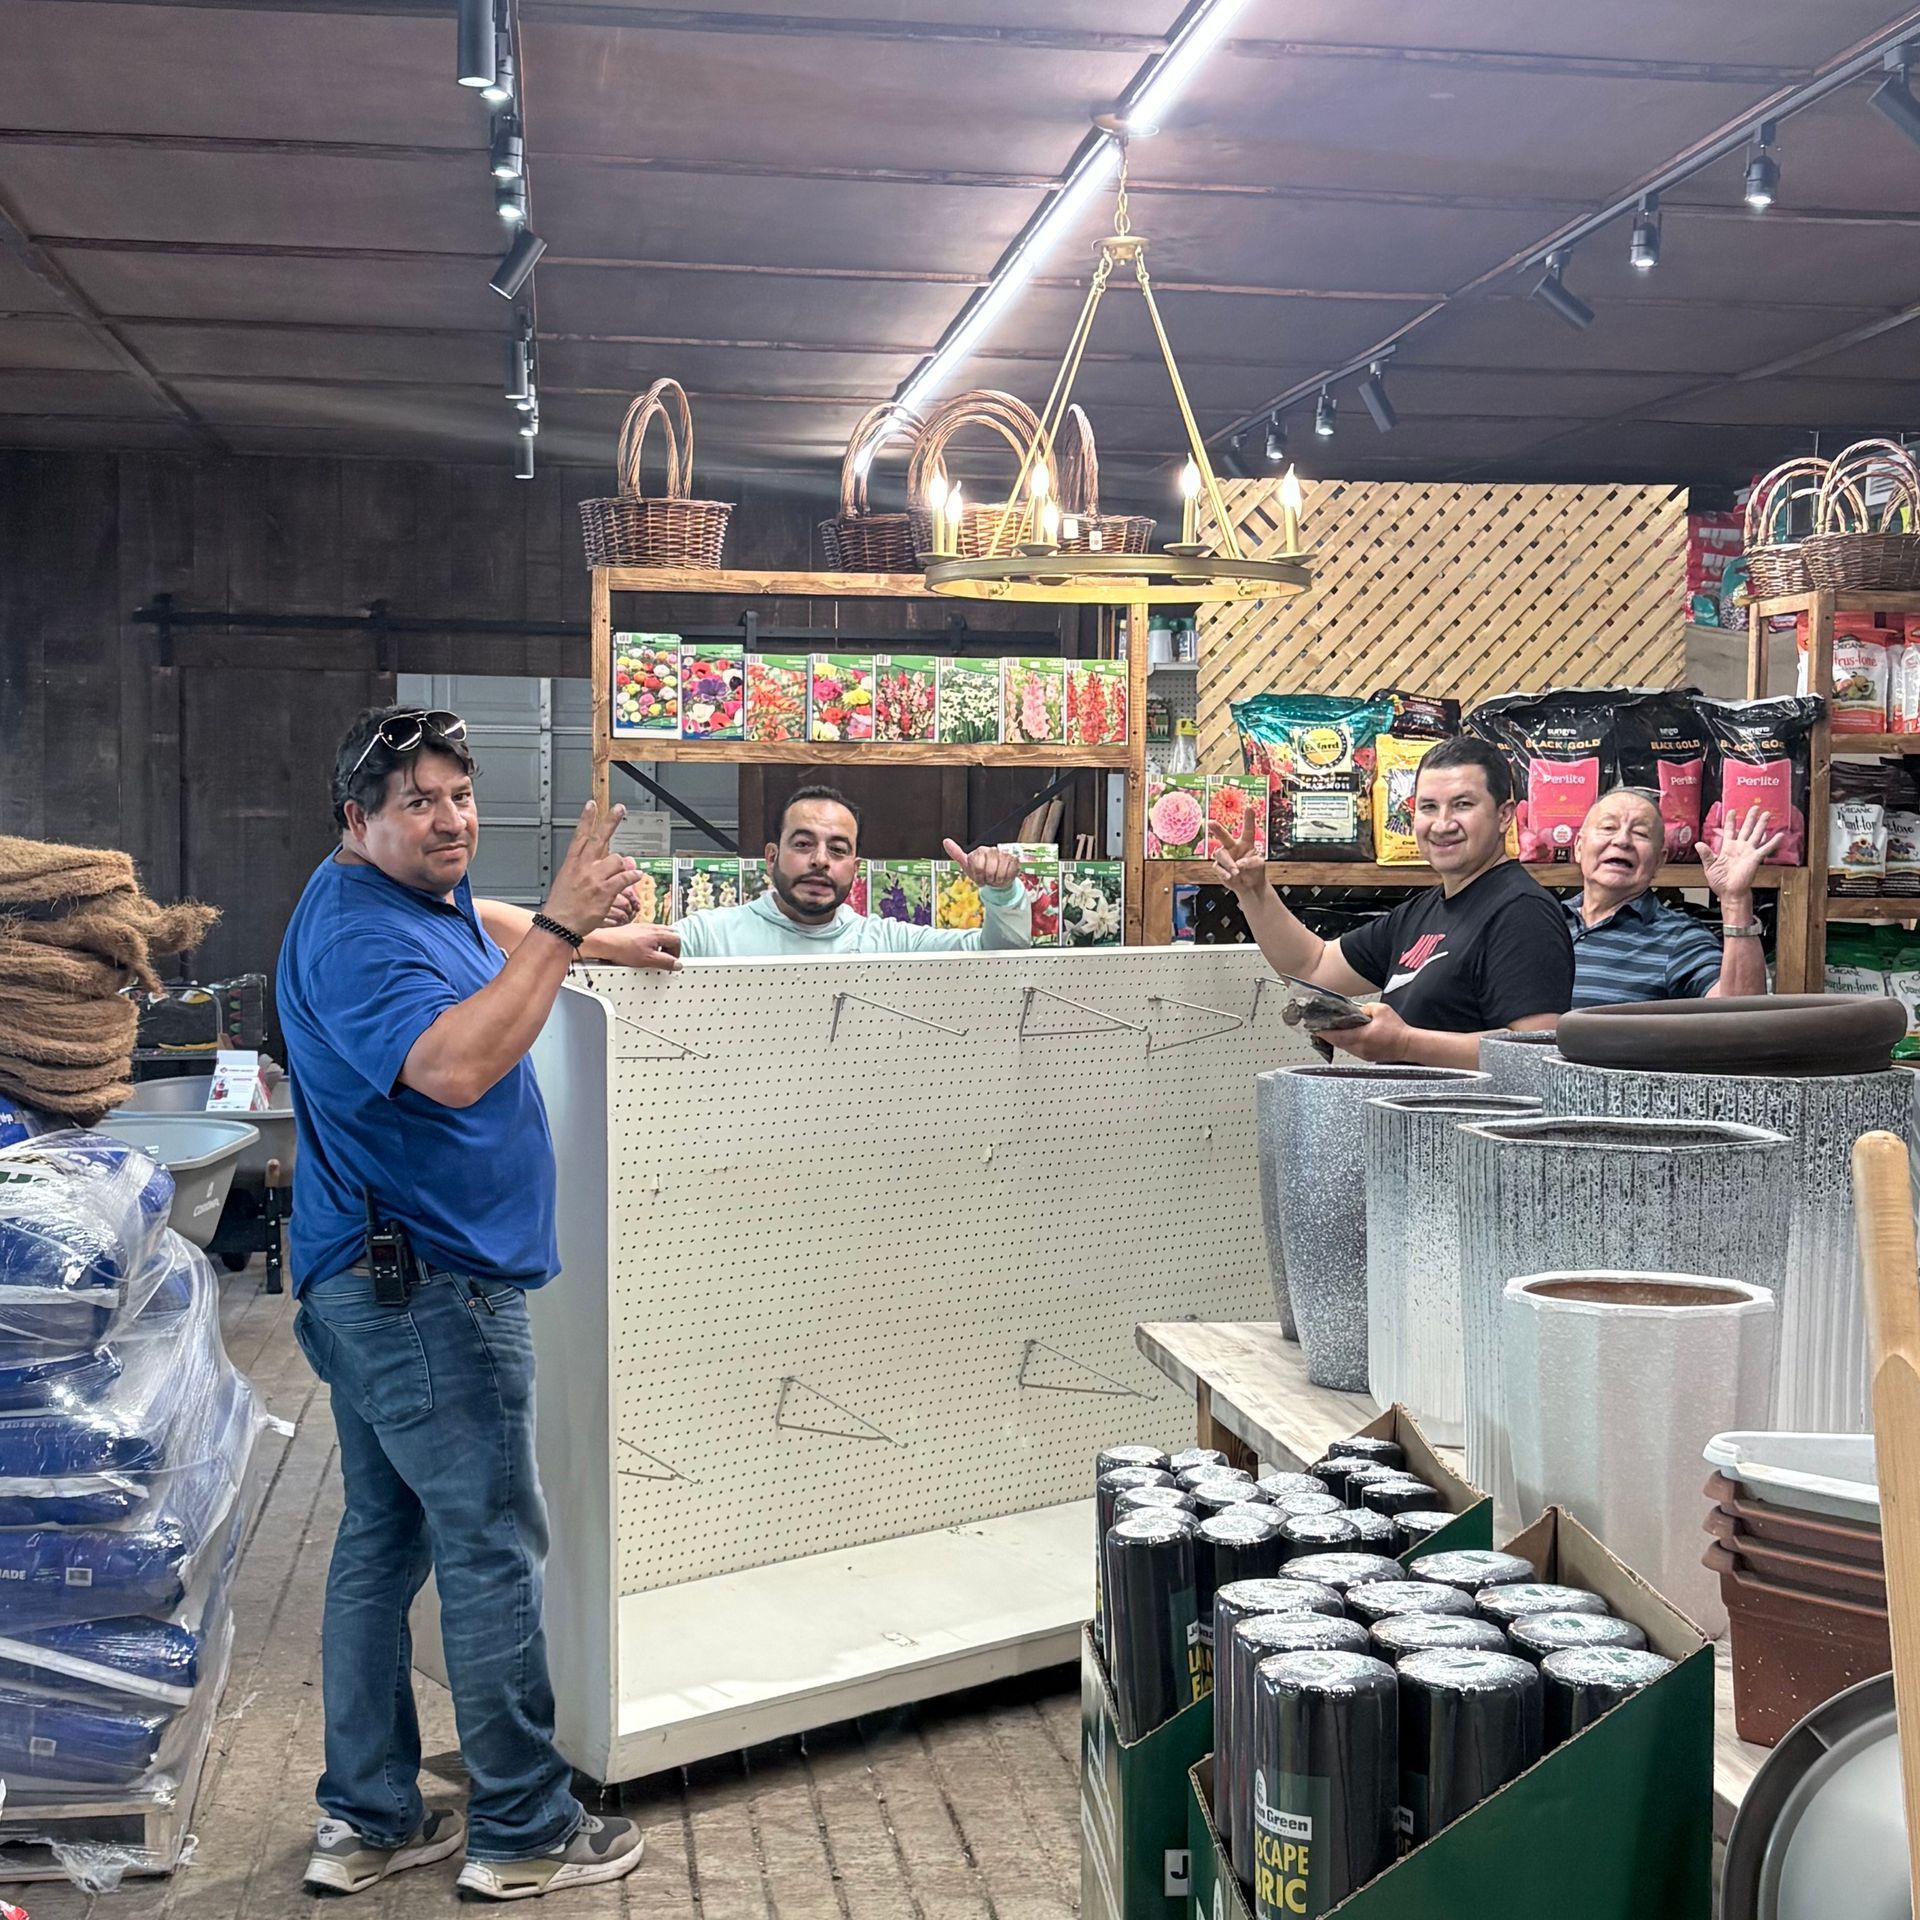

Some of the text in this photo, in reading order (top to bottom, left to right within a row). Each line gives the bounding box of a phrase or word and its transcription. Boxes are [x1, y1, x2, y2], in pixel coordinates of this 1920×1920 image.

[1833, 651, 1877, 667] trus-tone
[1525, 739, 1600, 750] BLACK GOLD
[1651, 739, 1700, 750] BLACK GOLD
[1720, 739, 1756, 752] BACK
[1542, 774, 1586, 785] Perlite
[1670, 776, 1698, 786] Perlite
[1736, 776, 1780, 786] Perlite
[0, 1569, 27, 1581] ADE
[1266, 1809, 1309, 1833] Green
[1257, 1830, 1309, 1876] SCAPE
[1256, 1862, 1307, 1914] BRIC
